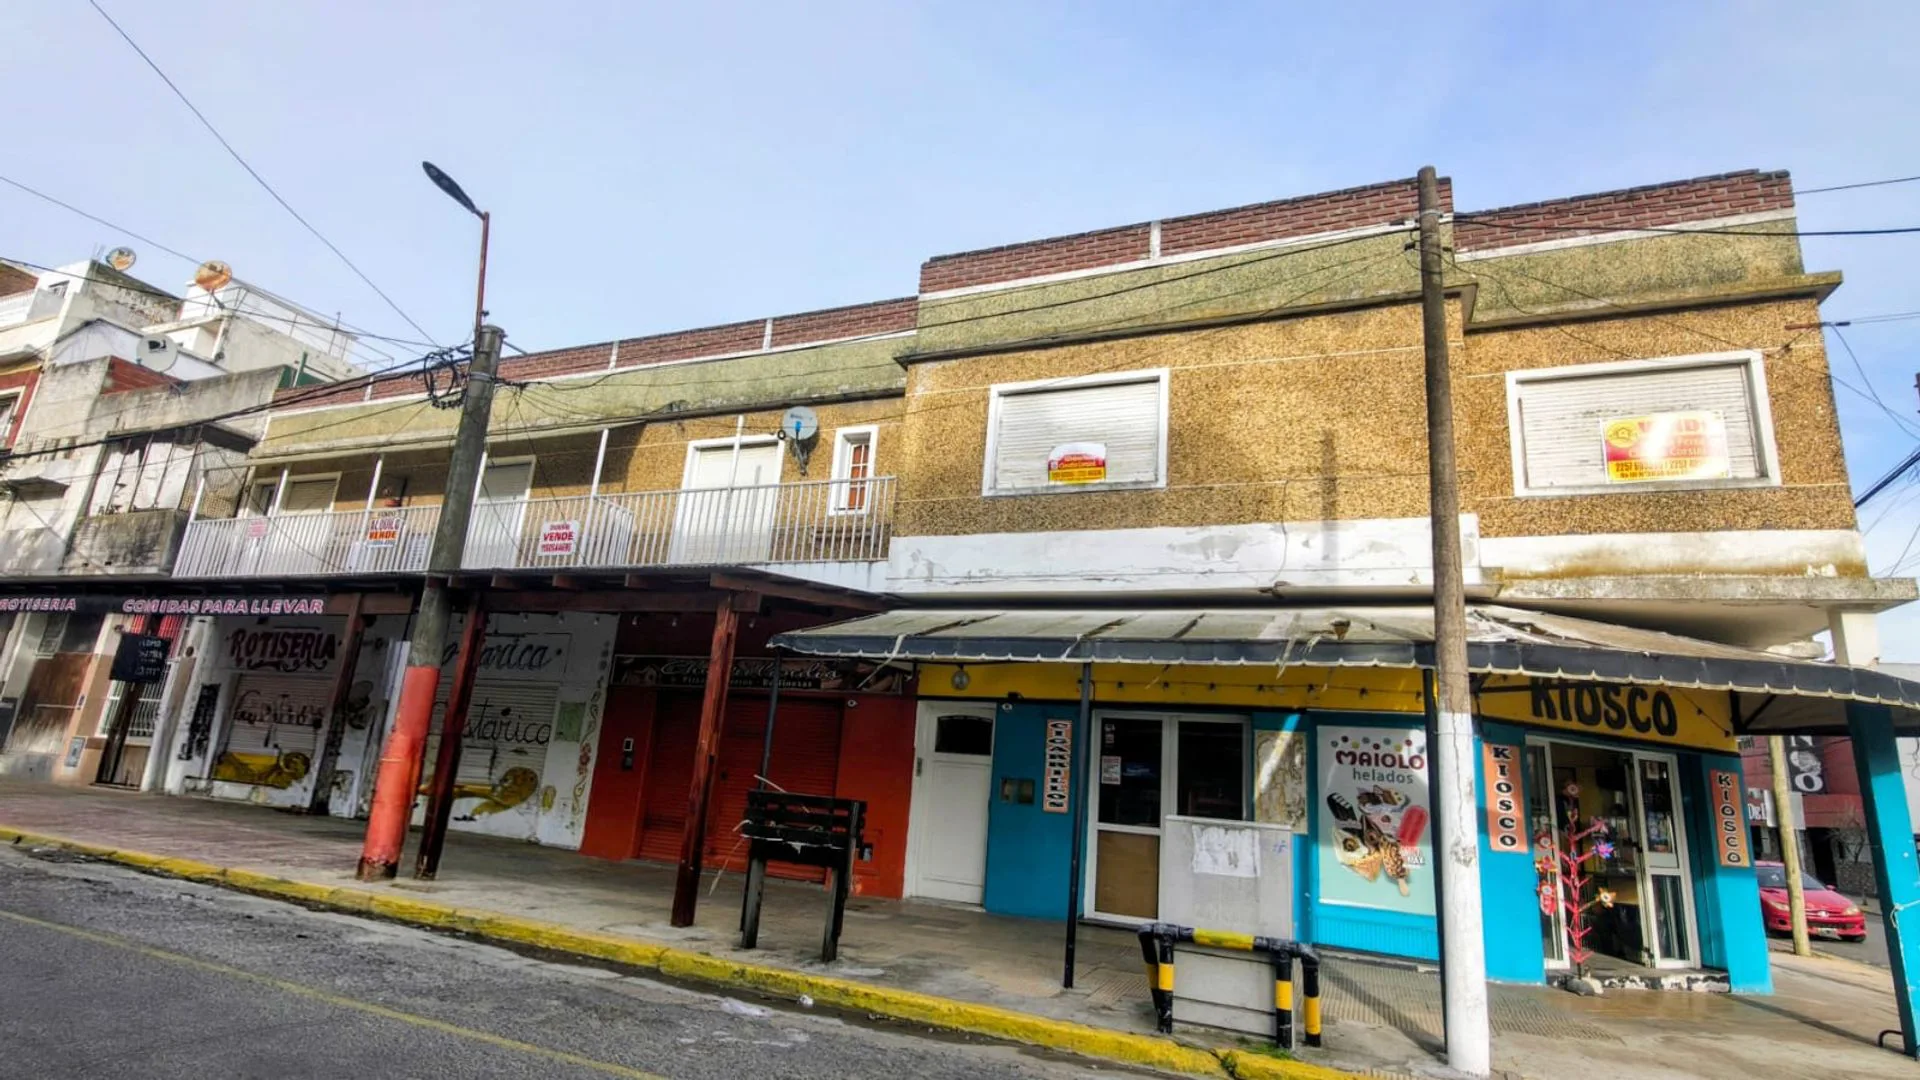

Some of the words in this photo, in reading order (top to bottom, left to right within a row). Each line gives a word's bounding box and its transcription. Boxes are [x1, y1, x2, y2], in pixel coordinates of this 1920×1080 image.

[543, 531, 575, 541] VENDE
[122, 598, 201, 613] COMIDAS
[201, 598, 249, 613] PARA
[250, 598, 325, 614] LLEVAR
[230, 628, 337, 664] ROTISERIA
[1529, 677, 1679, 737] KIOSCO
[1352, 767, 1415, 785] helados
[1491, 745, 1519, 847] KIOSCO
[1716, 773, 1742, 863] KIOSCO
